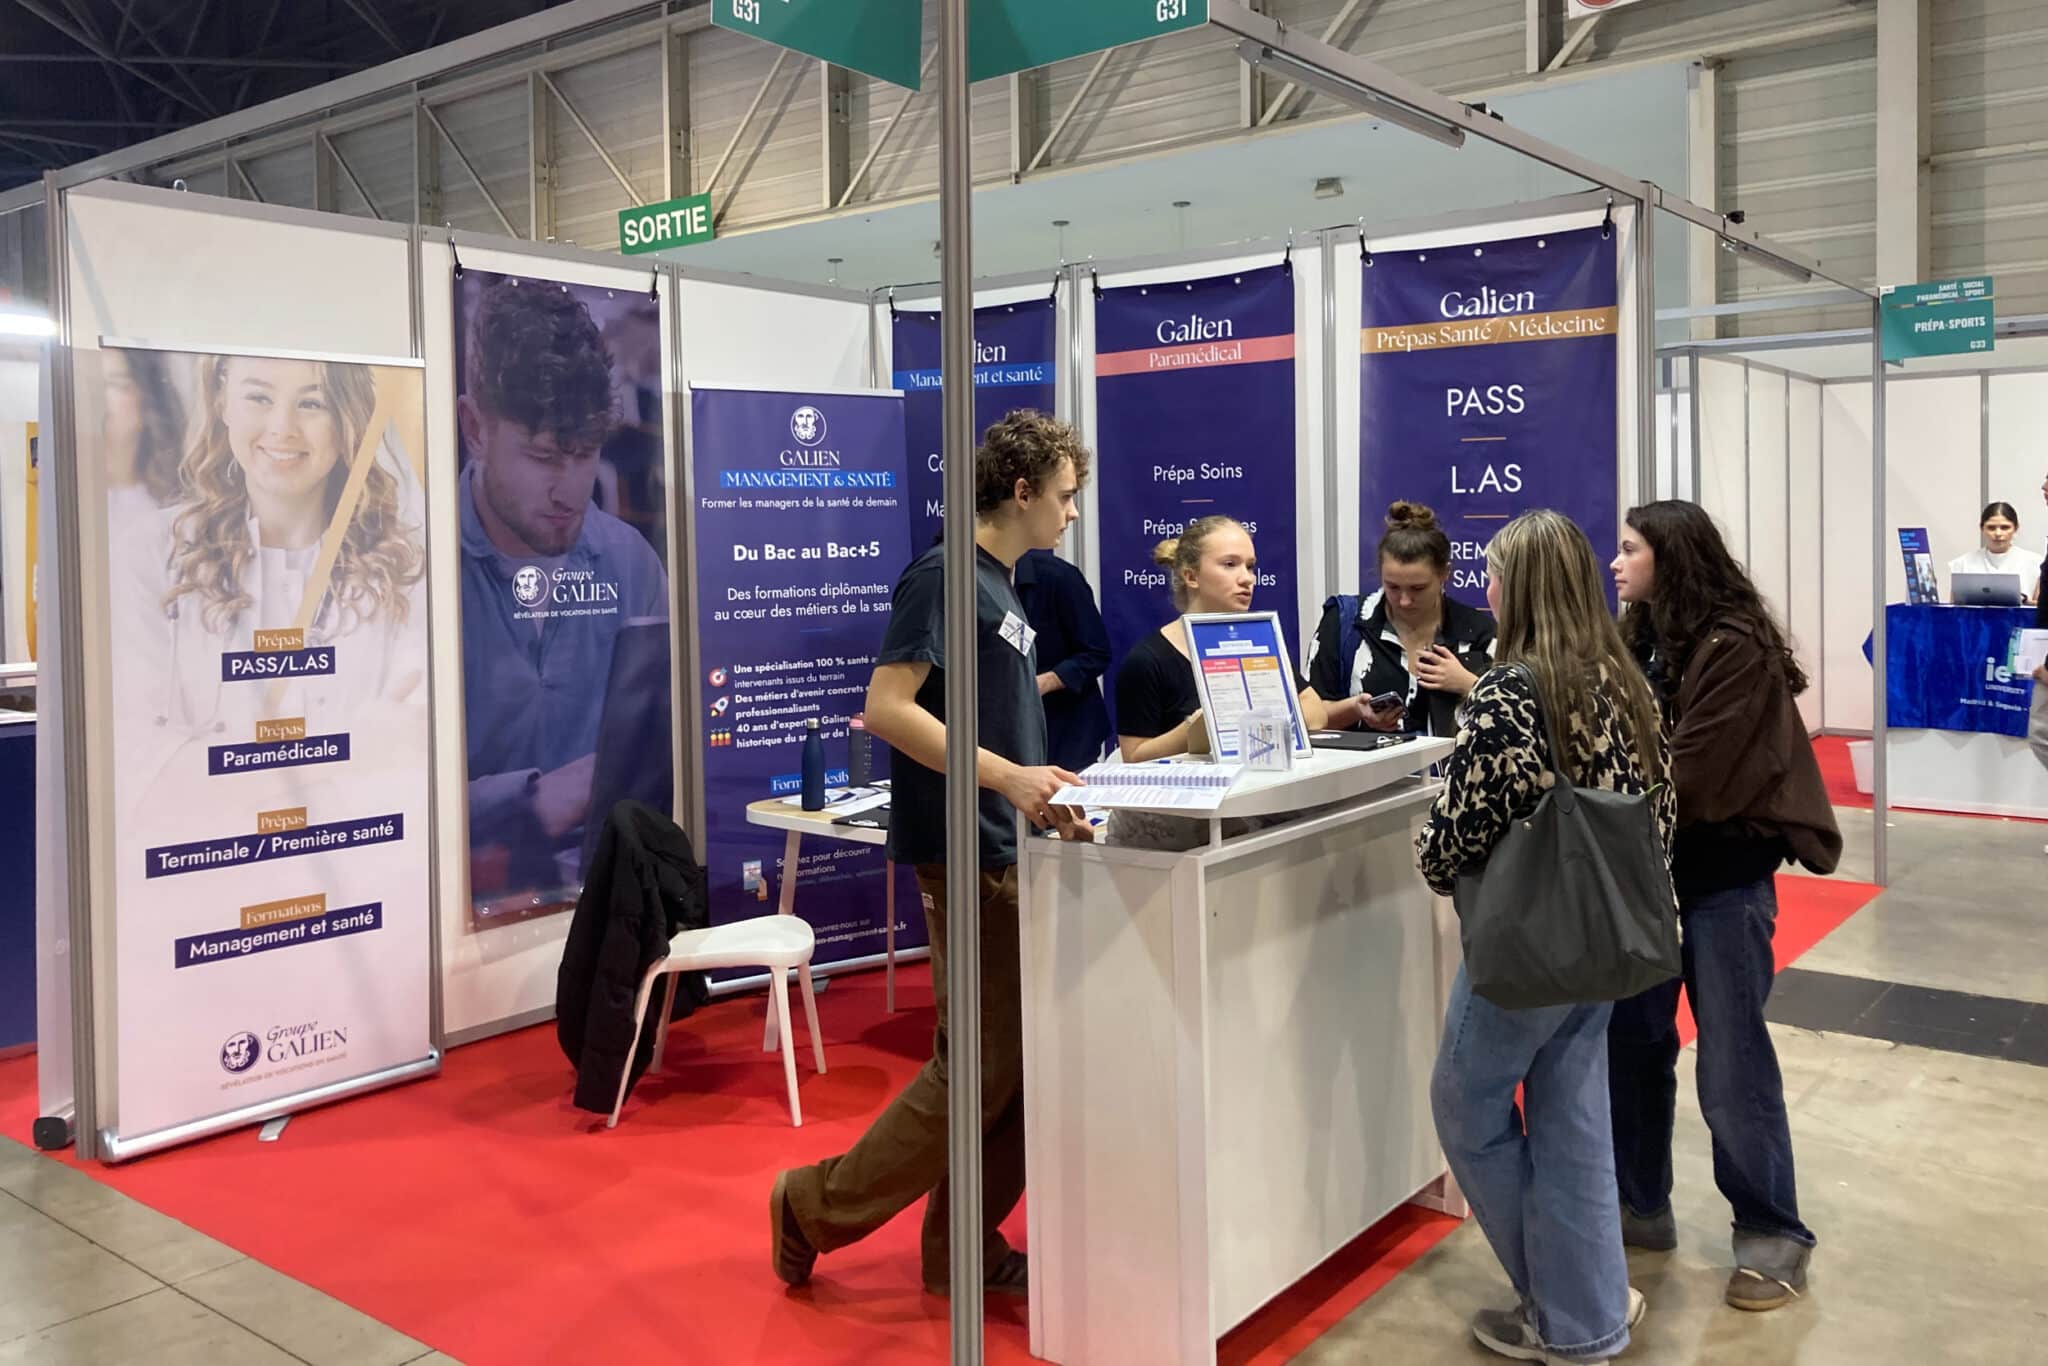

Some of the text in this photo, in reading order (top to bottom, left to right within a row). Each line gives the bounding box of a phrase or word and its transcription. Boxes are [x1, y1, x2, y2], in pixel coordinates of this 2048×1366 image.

[733, 0, 759, 24] G31
[1157, 0, 1186, 22] G31
[624, 205, 707, 246] SORTIE
[1440, 286, 1535, 319] Galien
[1156, 314, 1233, 344] Galien
[1377, 330, 1436, 352] Prépas
[1439, 324, 1492, 345] Santé
[1508, 314, 1606, 339] Médecine
[1915, 317, 1985, 332] PRÉPA-SPORTS
[1149, 342, 1242, 369] Paramédical
[991, 370, 1003, 384] et
[1006, 366, 1043, 383] santé
[1447, 384, 1525, 416] PASS
[780, 450, 840, 466] GALIEN
[727, 471, 891, 488] MANAGEMENT & SANTÉ
[1153, 462, 1243, 485] Prépa Soins
[1452, 464, 1522, 494] L.AS
[702, 496, 897, 511] Former les managers de la santé de demain
[1144, 518, 1183, 540] Prépa
[733, 541, 880, 562] Du Bac au Bac+5
[552, 568, 595, 584] Groupe
[1124, 569, 1166, 590] Prépa
[553, 583, 618, 603] GALIEN
[728, 582, 889, 601] Des formations diplômantes
[714, 599, 892, 621] au cœur des métiers de la san
[256, 634, 303, 651] Prépas
[231, 653, 329, 675] PASS/L.AS
[734, 664, 753, 674] Une
[755, 659, 814, 674] spécialisation
[816, 657, 834, 667] 100
[835, 657, 845, 666] %
[847, 655, 869, 665] santé
[734, 676, 784, 689] intervenants
[807, 672, 817, 682] du
[819, 671, 845, 681] terrain
[735, 685, 864, 704] Des métiers d'avenir concrets
[735, 704, 820, 721] professionnalisants
[259, 723, 304, 741] Prépas
[736, 723, 750, 733] 40
[752, 721, 769, 731] ans
[821, 714, 850, 725] Galien
[736, 735, 782, 749] historique
[784, 733, 797, 744] du
[832, 728, 844, 738] de
[223, 739, 338, 768] Paramédicale
[261, 813, 305, 832] Prépas
[158, 841, 249, 869] Terminale
[271, 829, 347, 853] Première
[352, 820, 394, 841] santé
[812, 852, 832, 864] pour
[246, 901, 322, 925] Formations
[190, 910, 374, 960] Management et santé
[267, 1020, 318, 1044] Groupe
[267, 1027, 347, 1063] GALIEN
